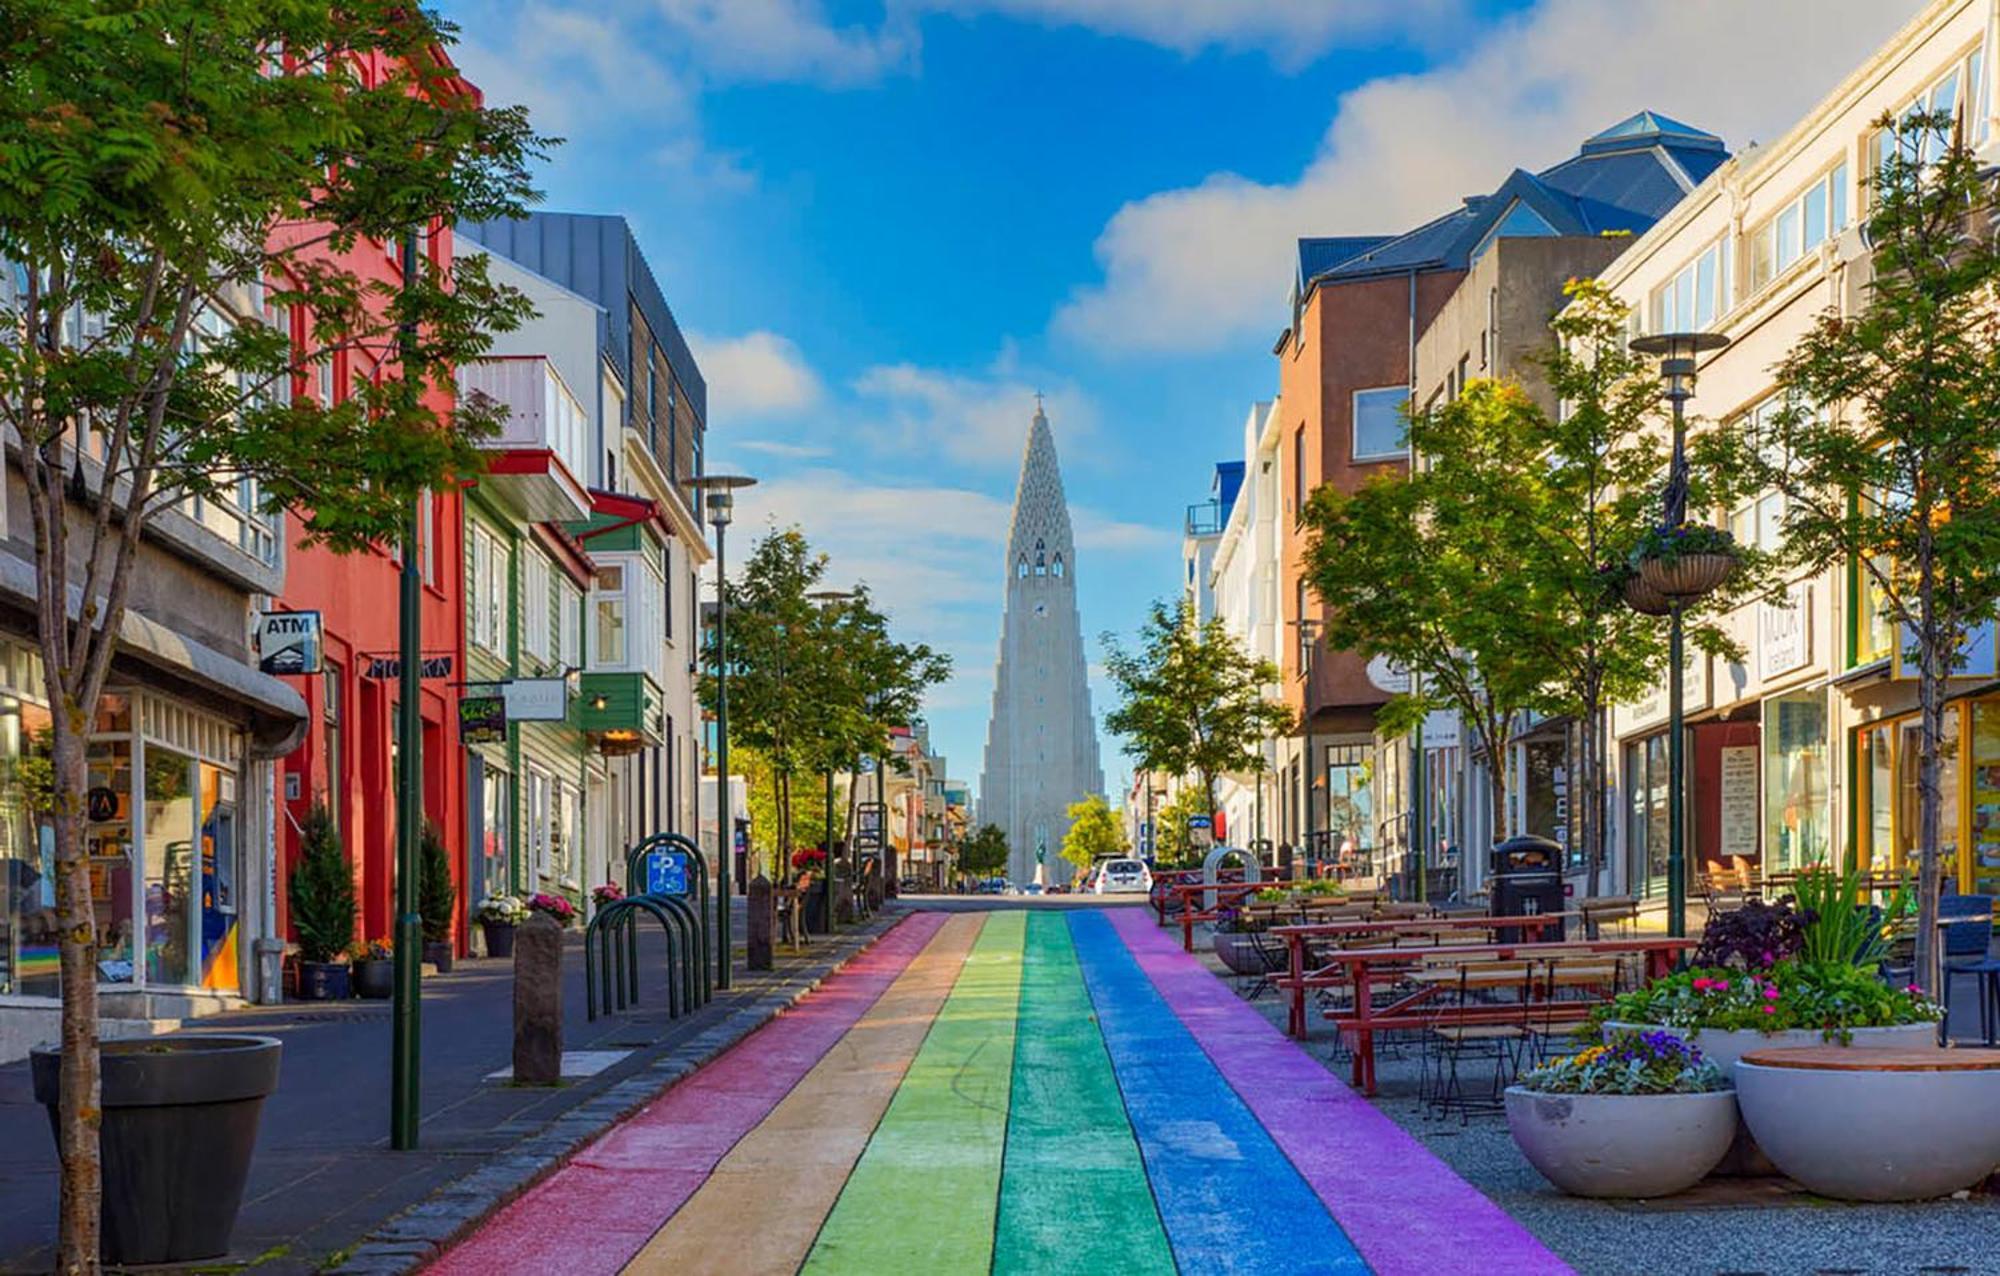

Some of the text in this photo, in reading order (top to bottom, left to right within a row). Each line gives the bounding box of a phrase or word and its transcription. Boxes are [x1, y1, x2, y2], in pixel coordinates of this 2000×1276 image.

[267, 618, 310, 634] ATM
[371, 658, 450, 681] MOKA
[660, 857, 675, 875] P
